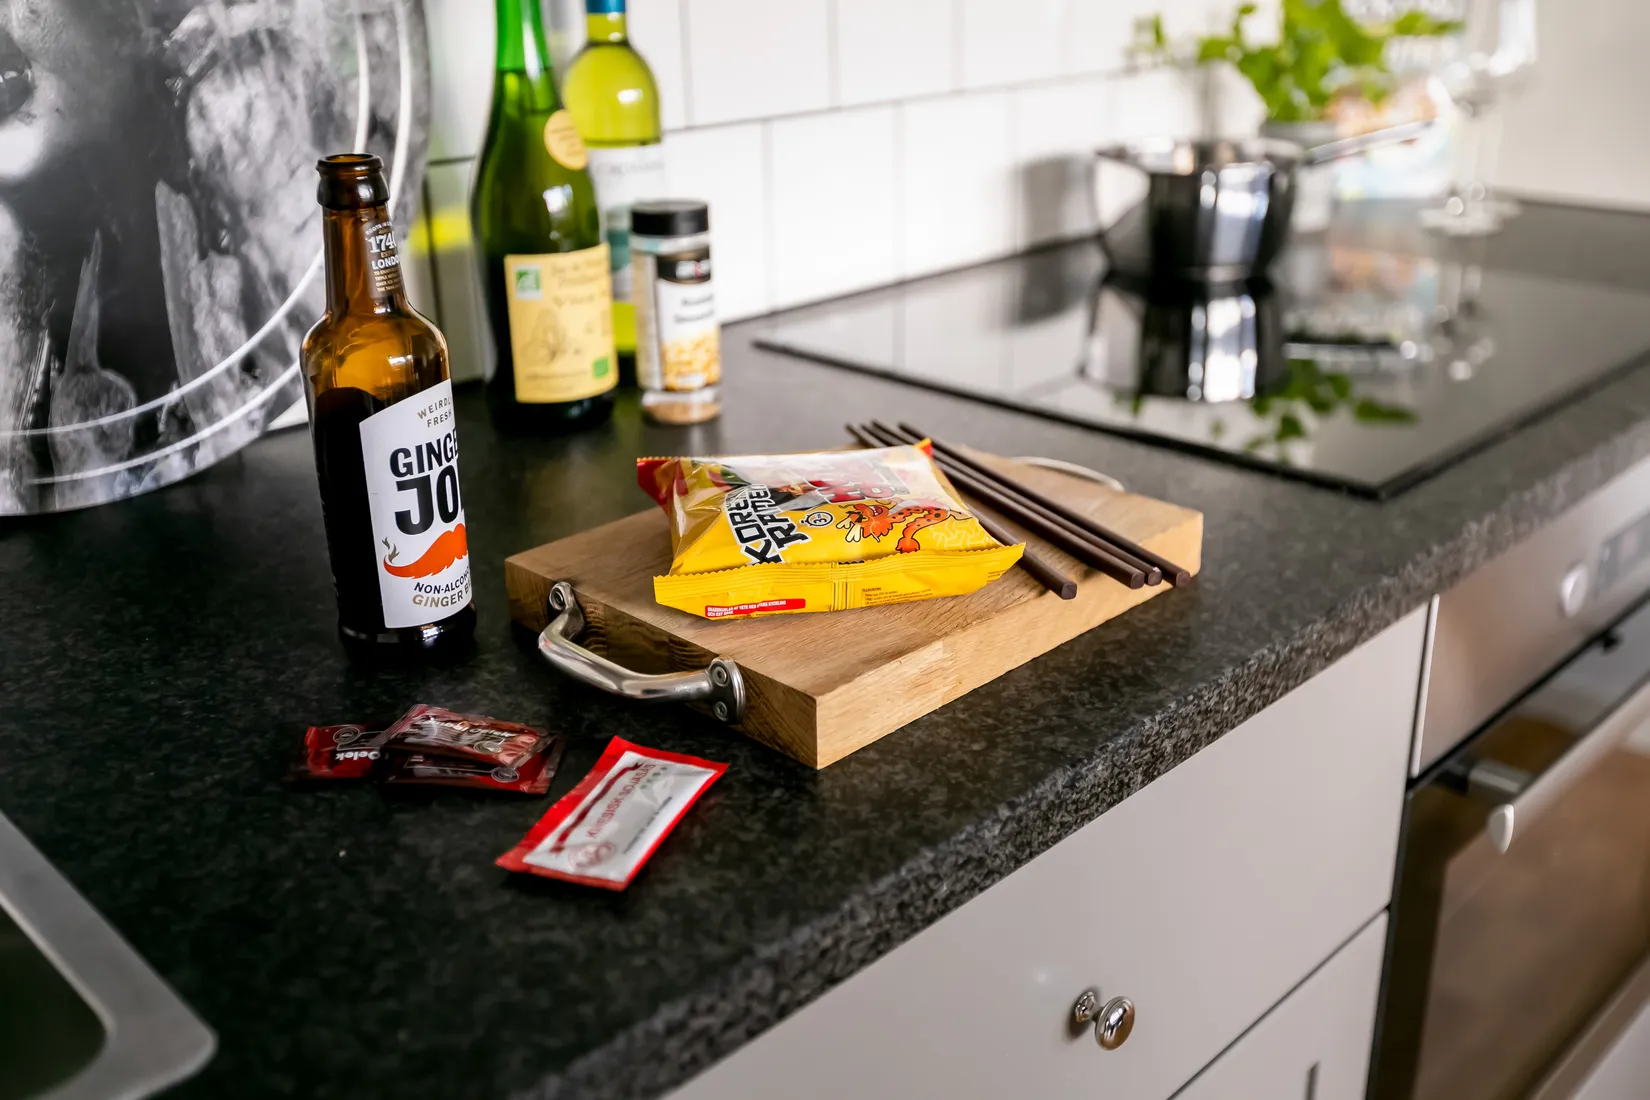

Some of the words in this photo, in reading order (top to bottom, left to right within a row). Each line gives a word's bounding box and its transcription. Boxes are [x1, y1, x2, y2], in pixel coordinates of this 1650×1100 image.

[371, 255, 400, 270] LONDO
[417, 396, 452, 420] WEIRDL
[389, 427, 459, 478] GINGE
[394, 465, 461, 536] JO
[412, 590, 464, 608] GINGER
